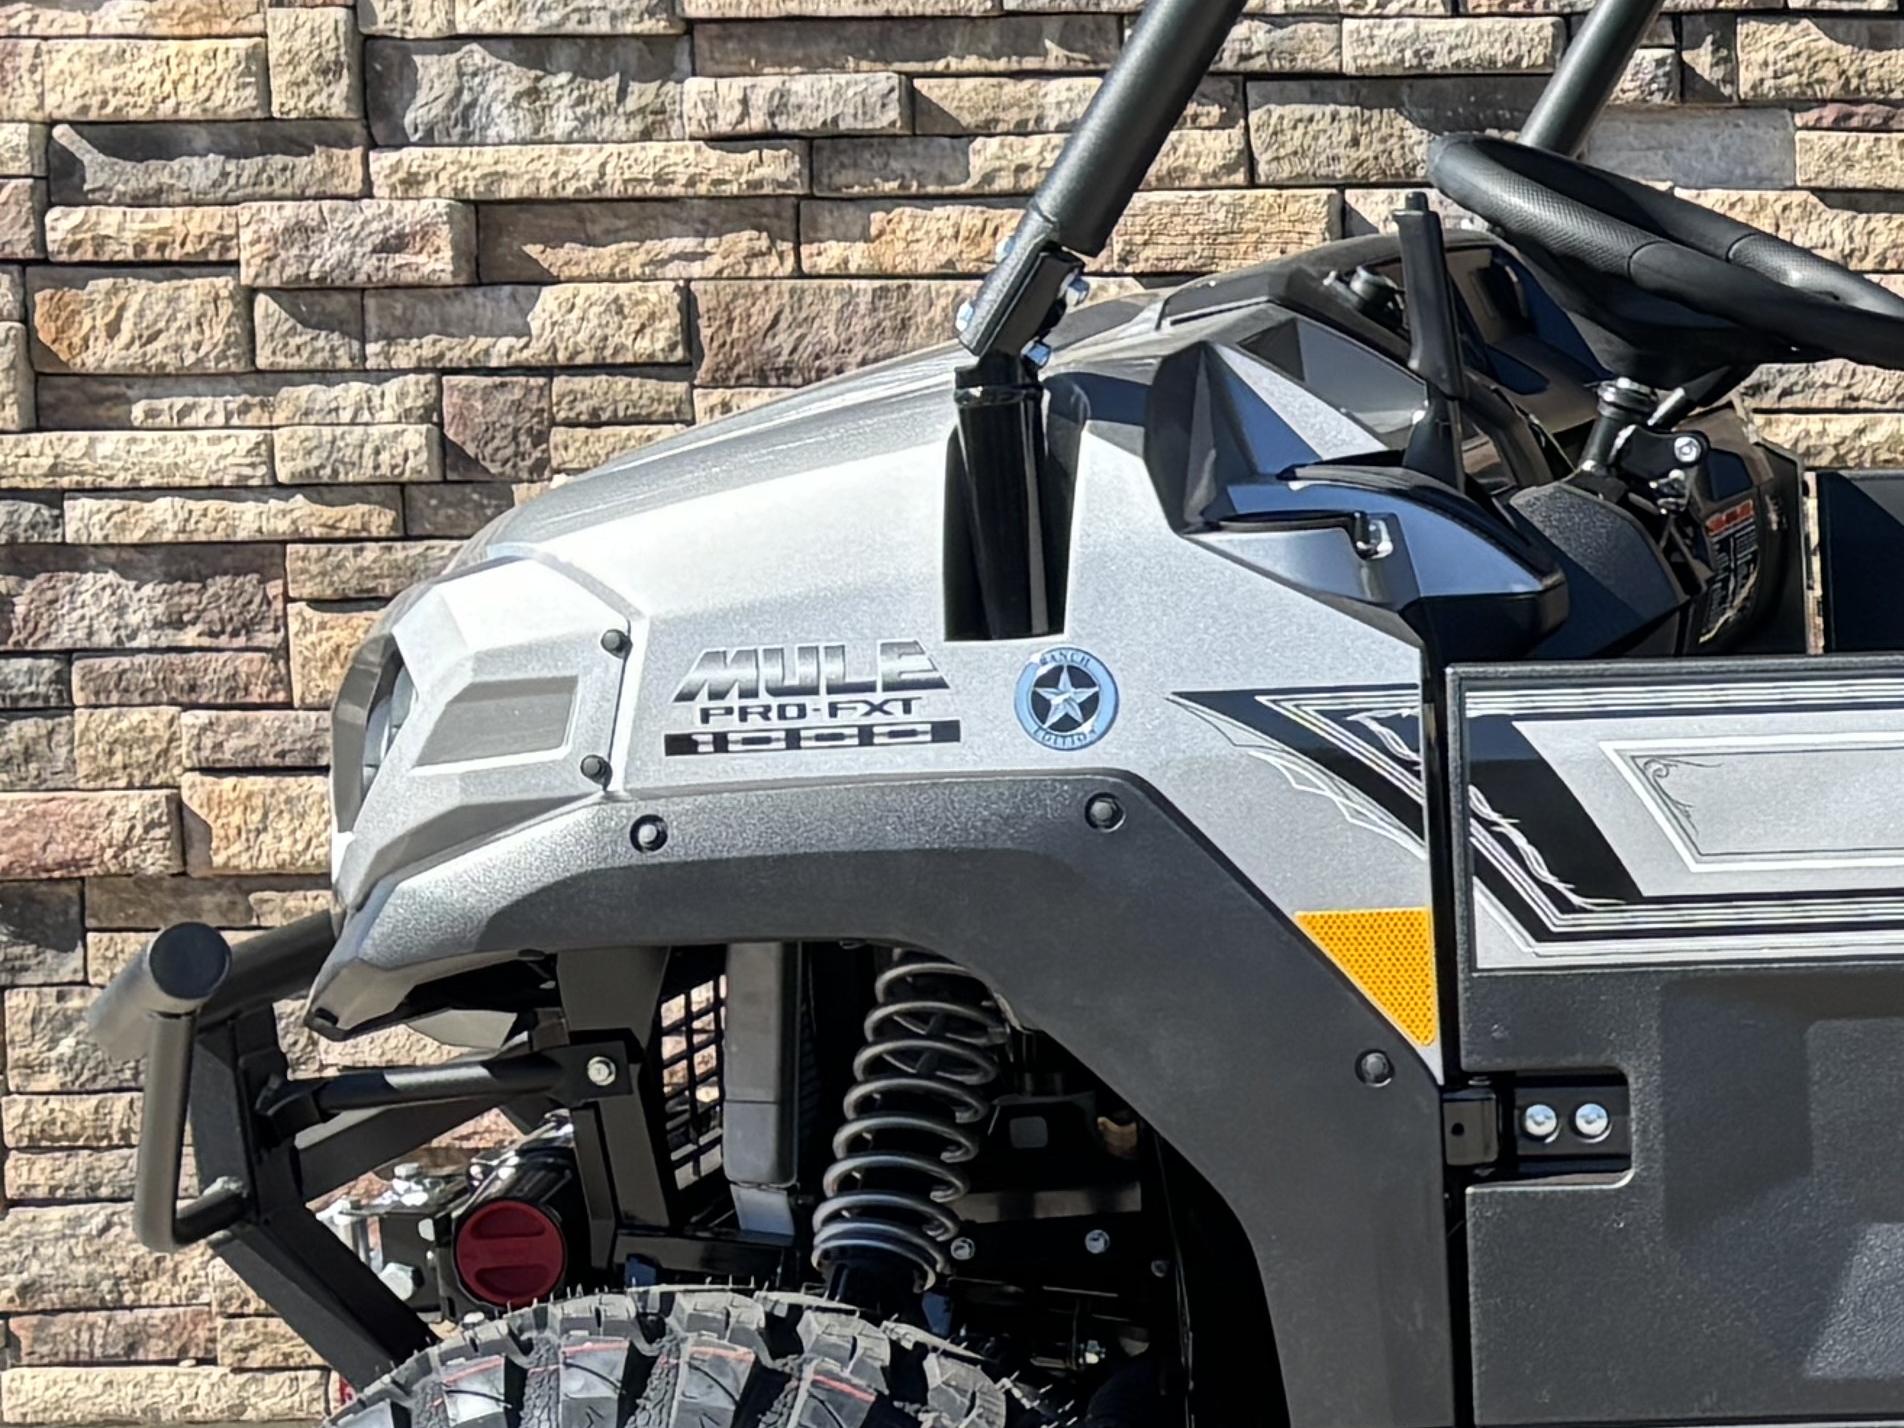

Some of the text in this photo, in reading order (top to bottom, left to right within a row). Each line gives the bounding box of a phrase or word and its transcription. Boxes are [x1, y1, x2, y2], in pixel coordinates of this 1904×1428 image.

[672, 639, 950, 703] MULE
[699, 696, 922, 725] PRO-FXT
[690, 721, 933, 754] 1000
